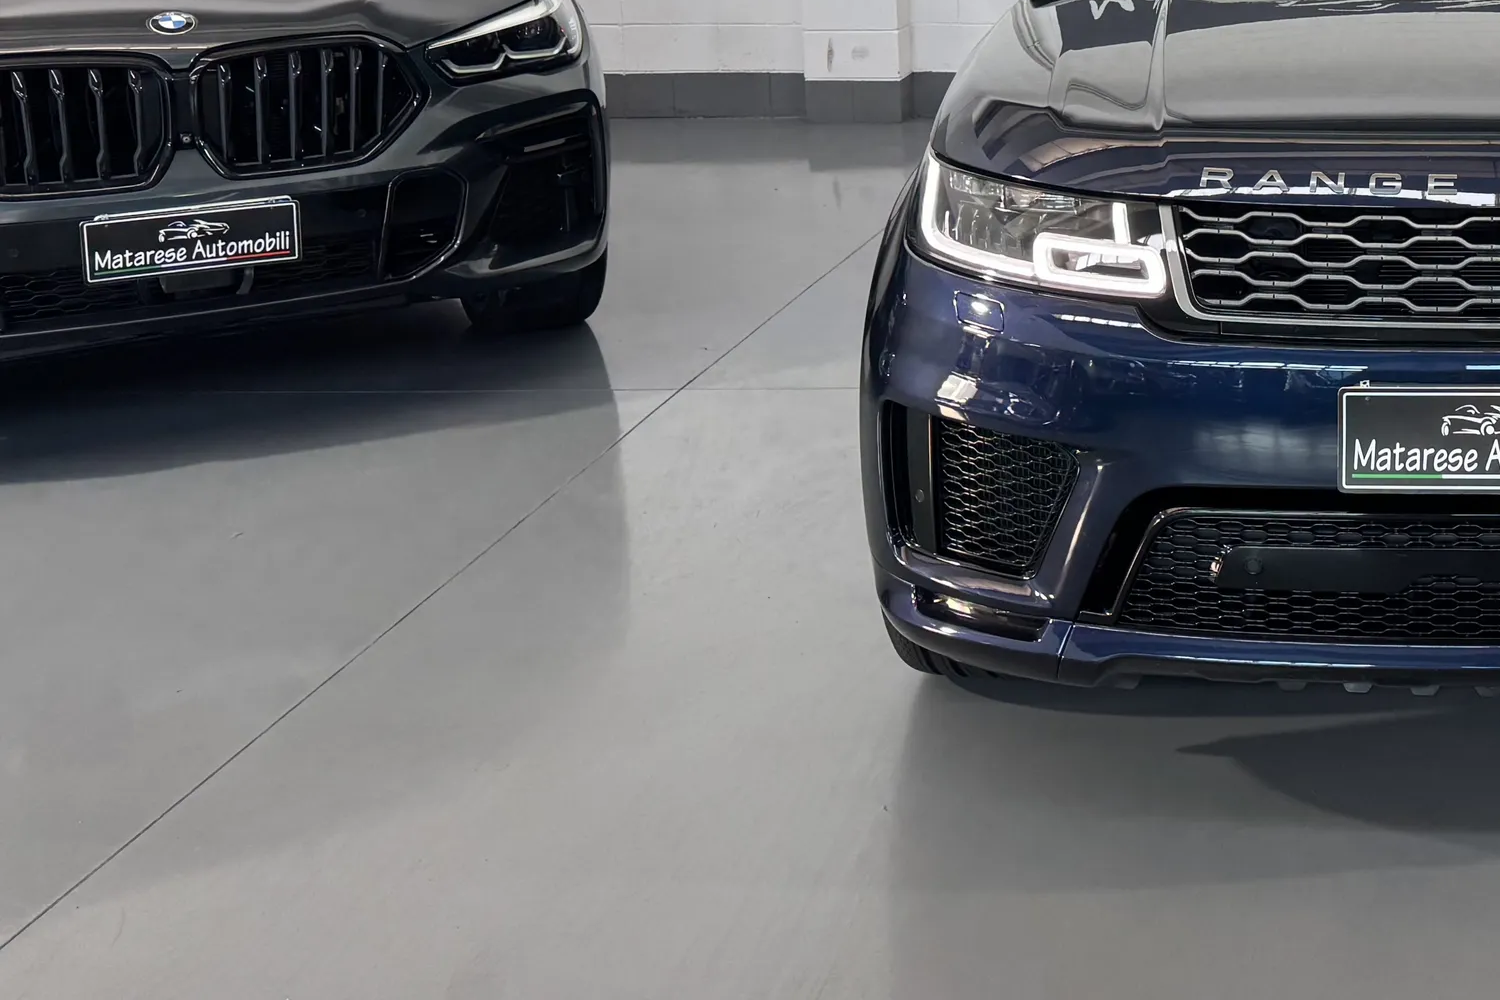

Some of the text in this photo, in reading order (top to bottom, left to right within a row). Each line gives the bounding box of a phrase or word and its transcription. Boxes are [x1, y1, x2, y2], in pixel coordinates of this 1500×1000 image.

[1199, 166, 1458, 195] RANGE
[94, 231, 290, 271] Matarese Automobili
[1353, 438, 1479, 473] Matarese
